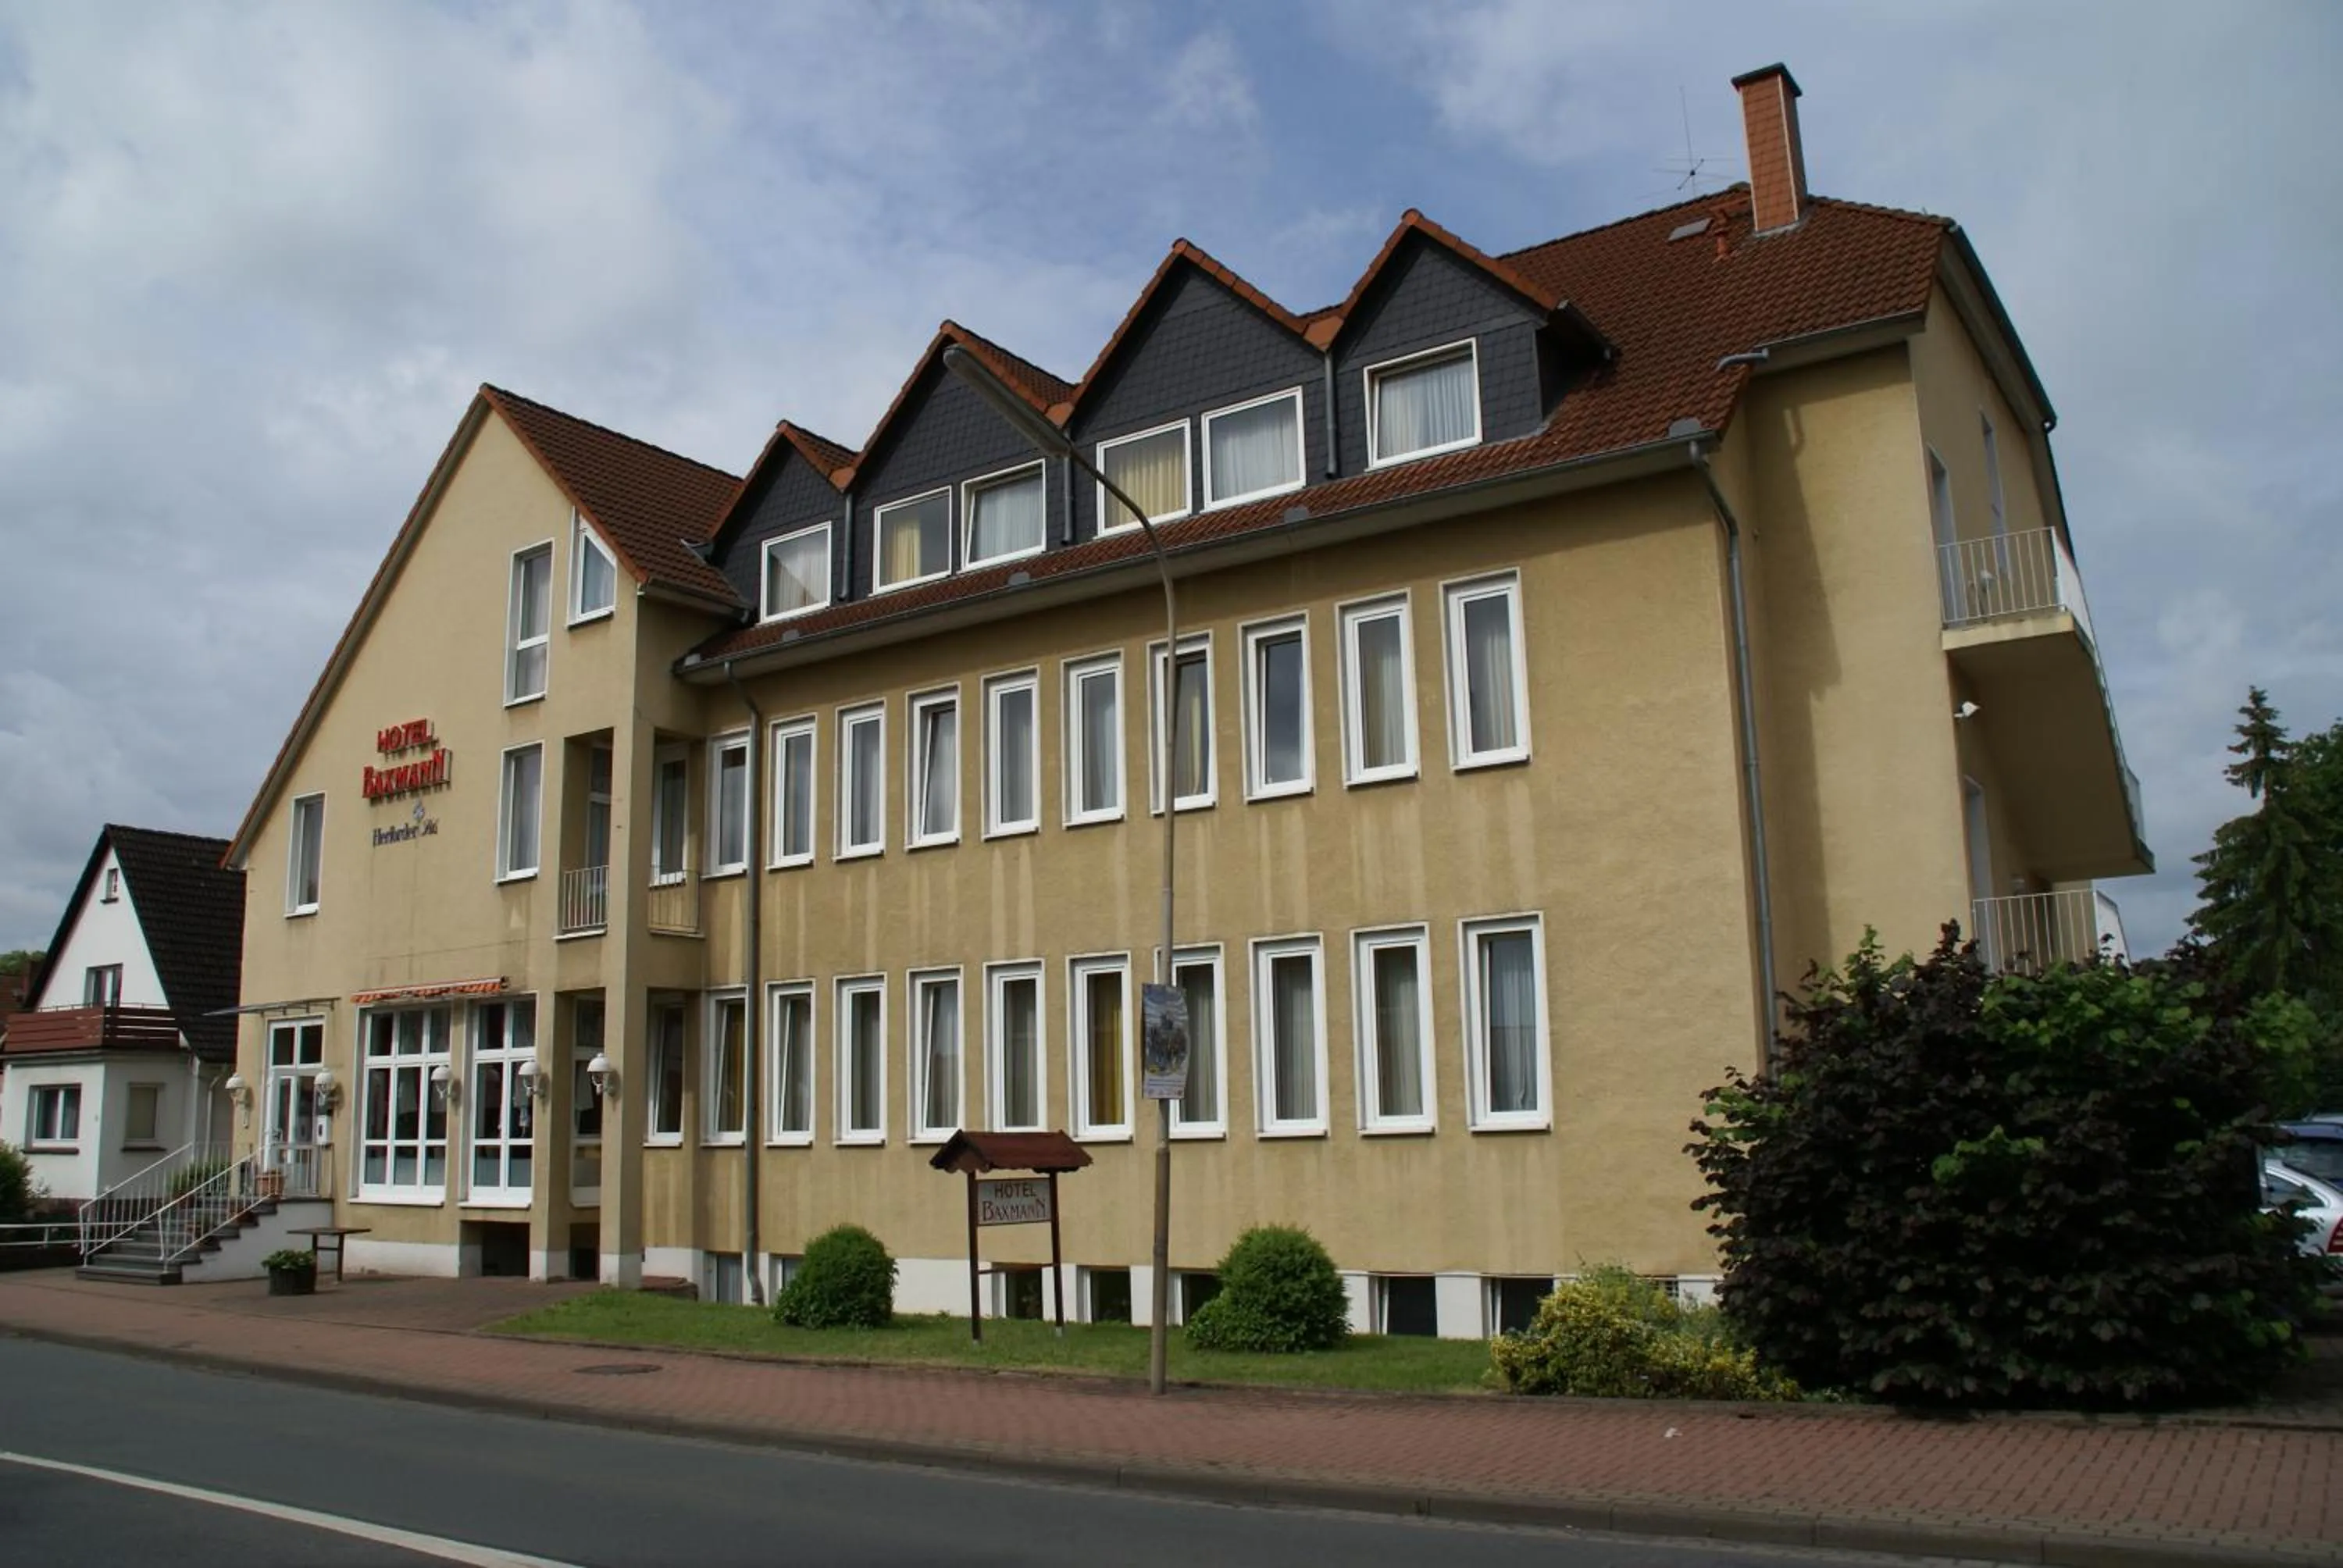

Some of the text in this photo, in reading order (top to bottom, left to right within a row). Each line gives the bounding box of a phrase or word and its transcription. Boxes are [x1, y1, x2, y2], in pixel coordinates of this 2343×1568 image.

[377, 718, 433, 753] HOTEL
[994, 1181, 1037, 1198] HOTEL
[982, 1199, 1047, 1221] BAXMANN
